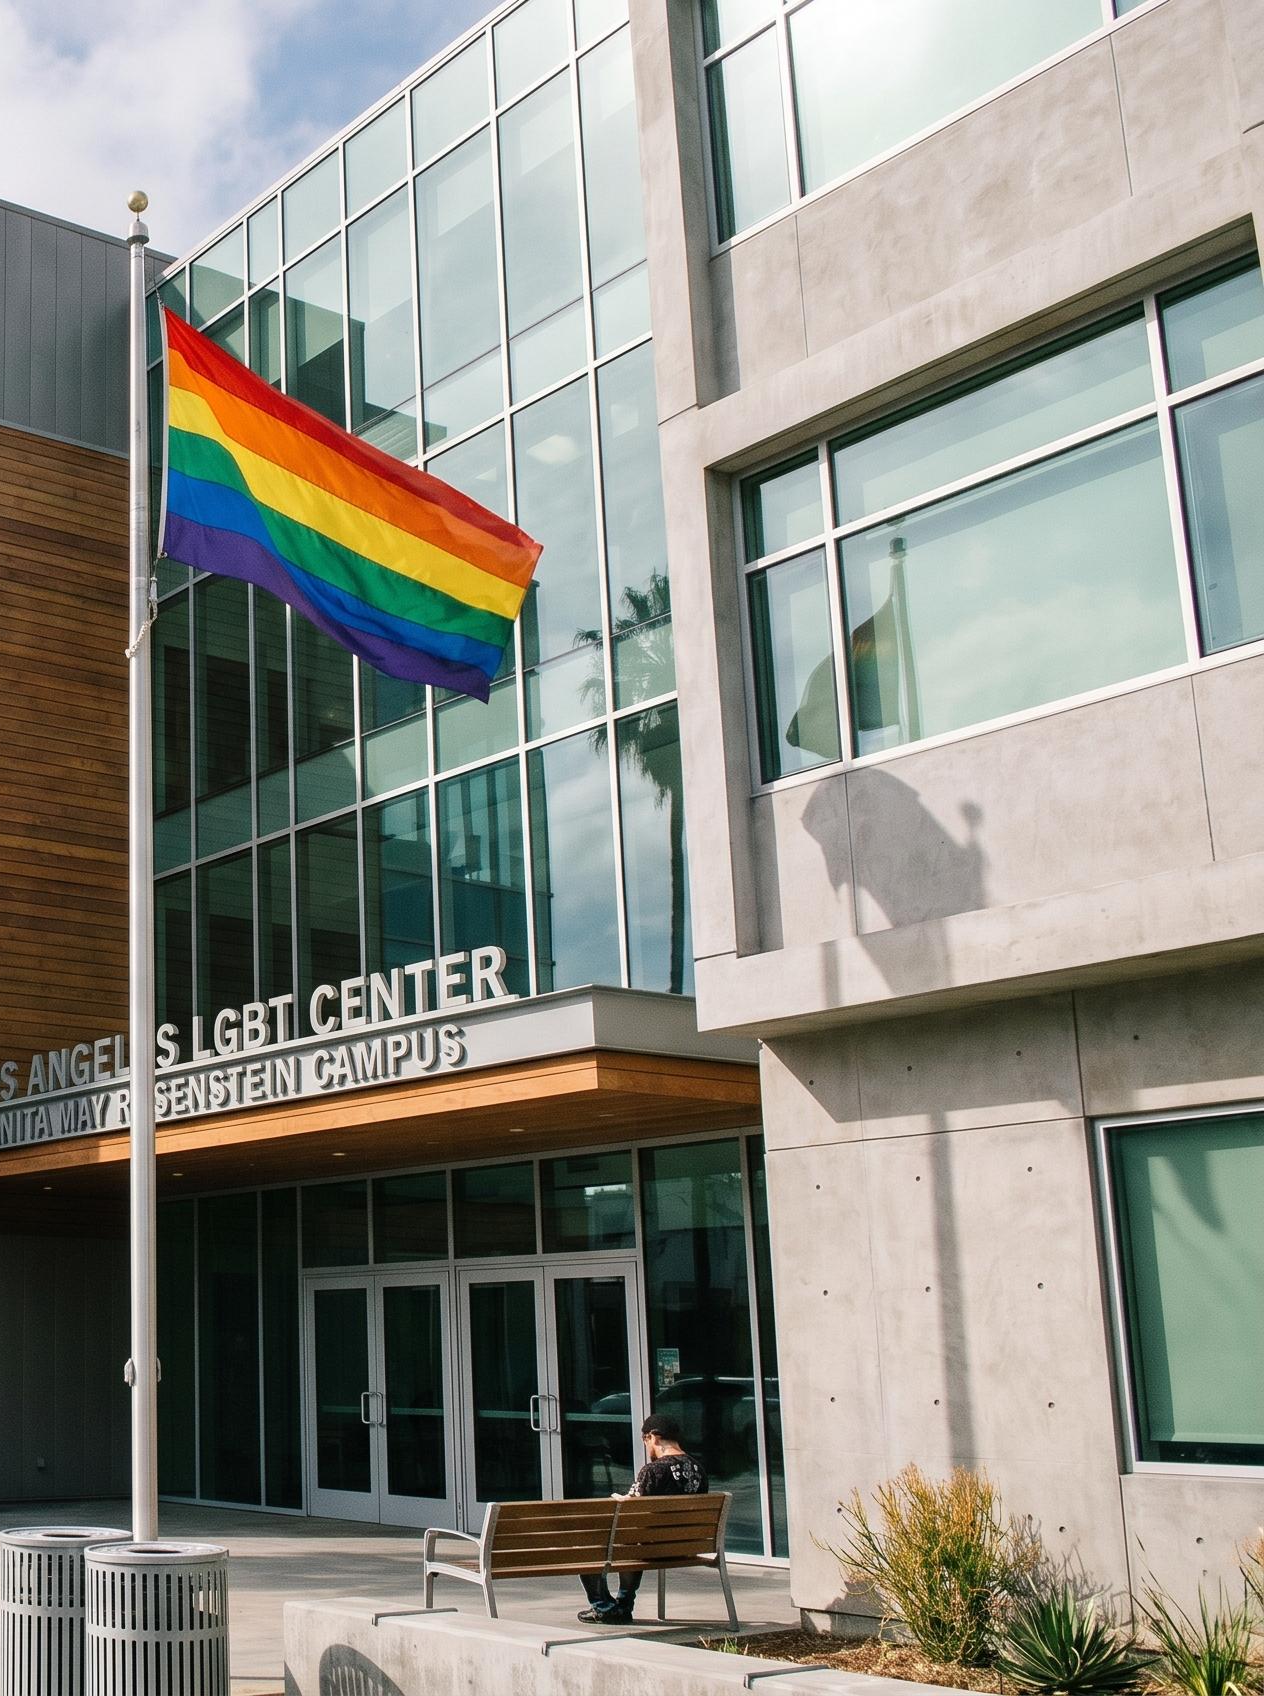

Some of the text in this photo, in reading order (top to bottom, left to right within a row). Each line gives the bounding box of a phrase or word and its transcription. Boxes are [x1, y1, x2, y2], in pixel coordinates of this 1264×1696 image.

[27, 1023, 180, 1096] ANGELS
[192, 993, 294, 1061] LGBT
[309, 945, 509, 1035] CENTER
[59, 1092, 111, 1135] MAY
[117, 1055, 302, 1126] RSENSTEIN
[312, 1023, 467, 1089] CAMPUS
